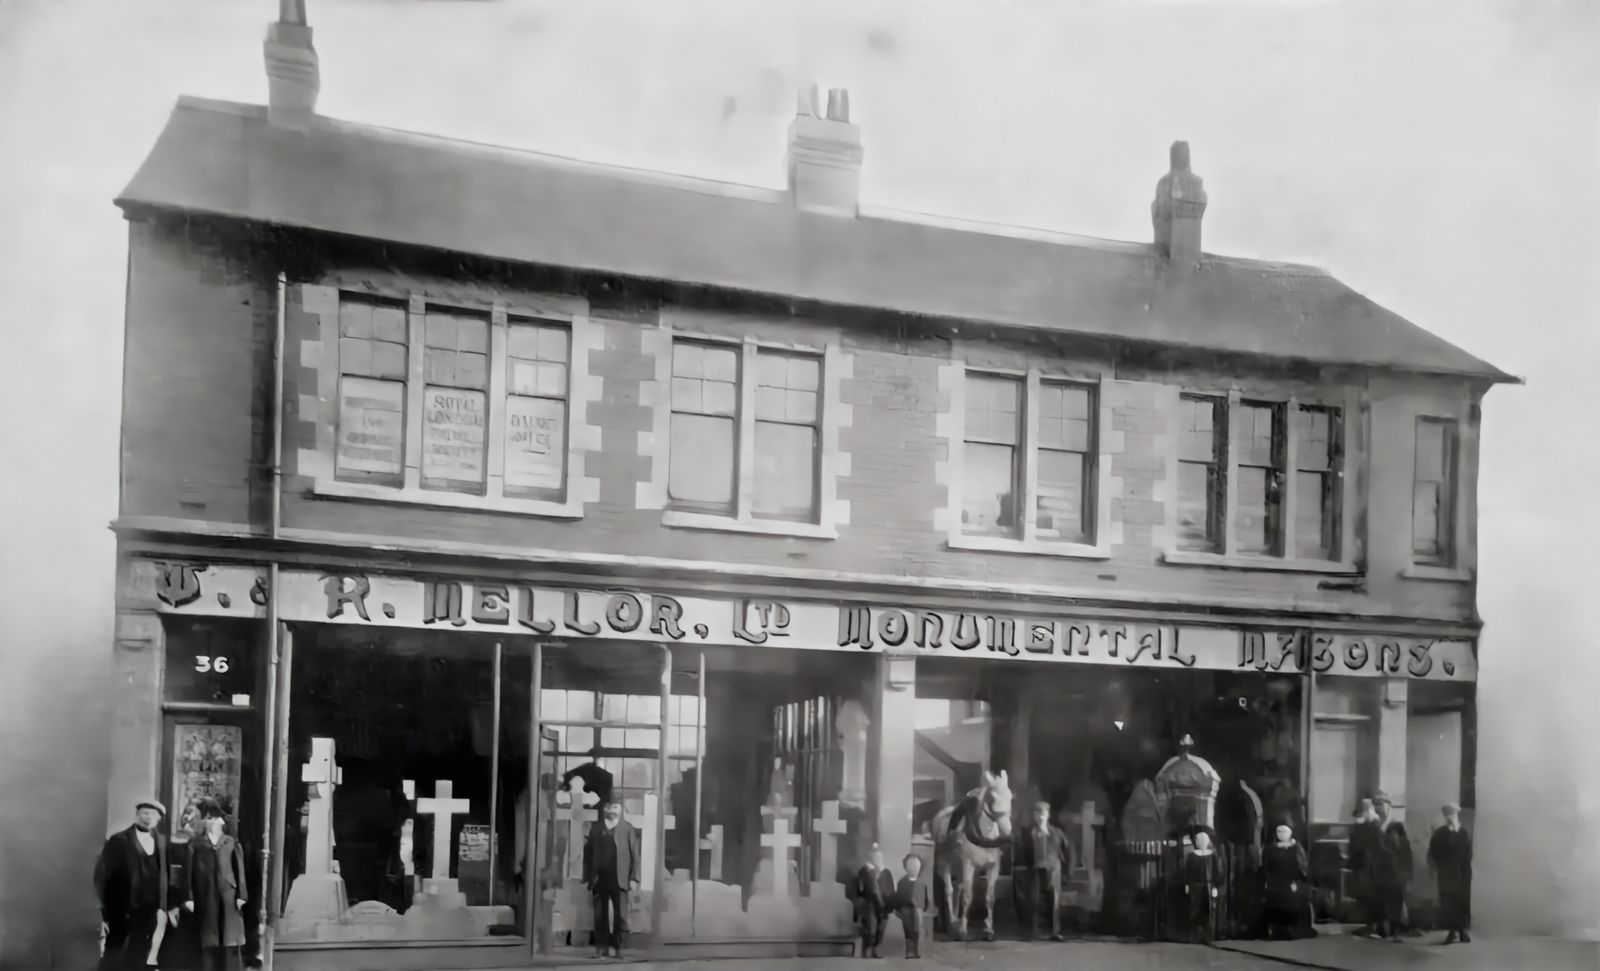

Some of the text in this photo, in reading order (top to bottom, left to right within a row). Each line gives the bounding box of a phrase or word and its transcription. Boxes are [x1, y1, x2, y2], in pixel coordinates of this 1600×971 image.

[319, 573, 396, 622] R.
[423, 580, 708, 640] MELLOR.
[837, 607, 1196, 667] MONUMENTAL
[195, 655, 229, 673] 36
